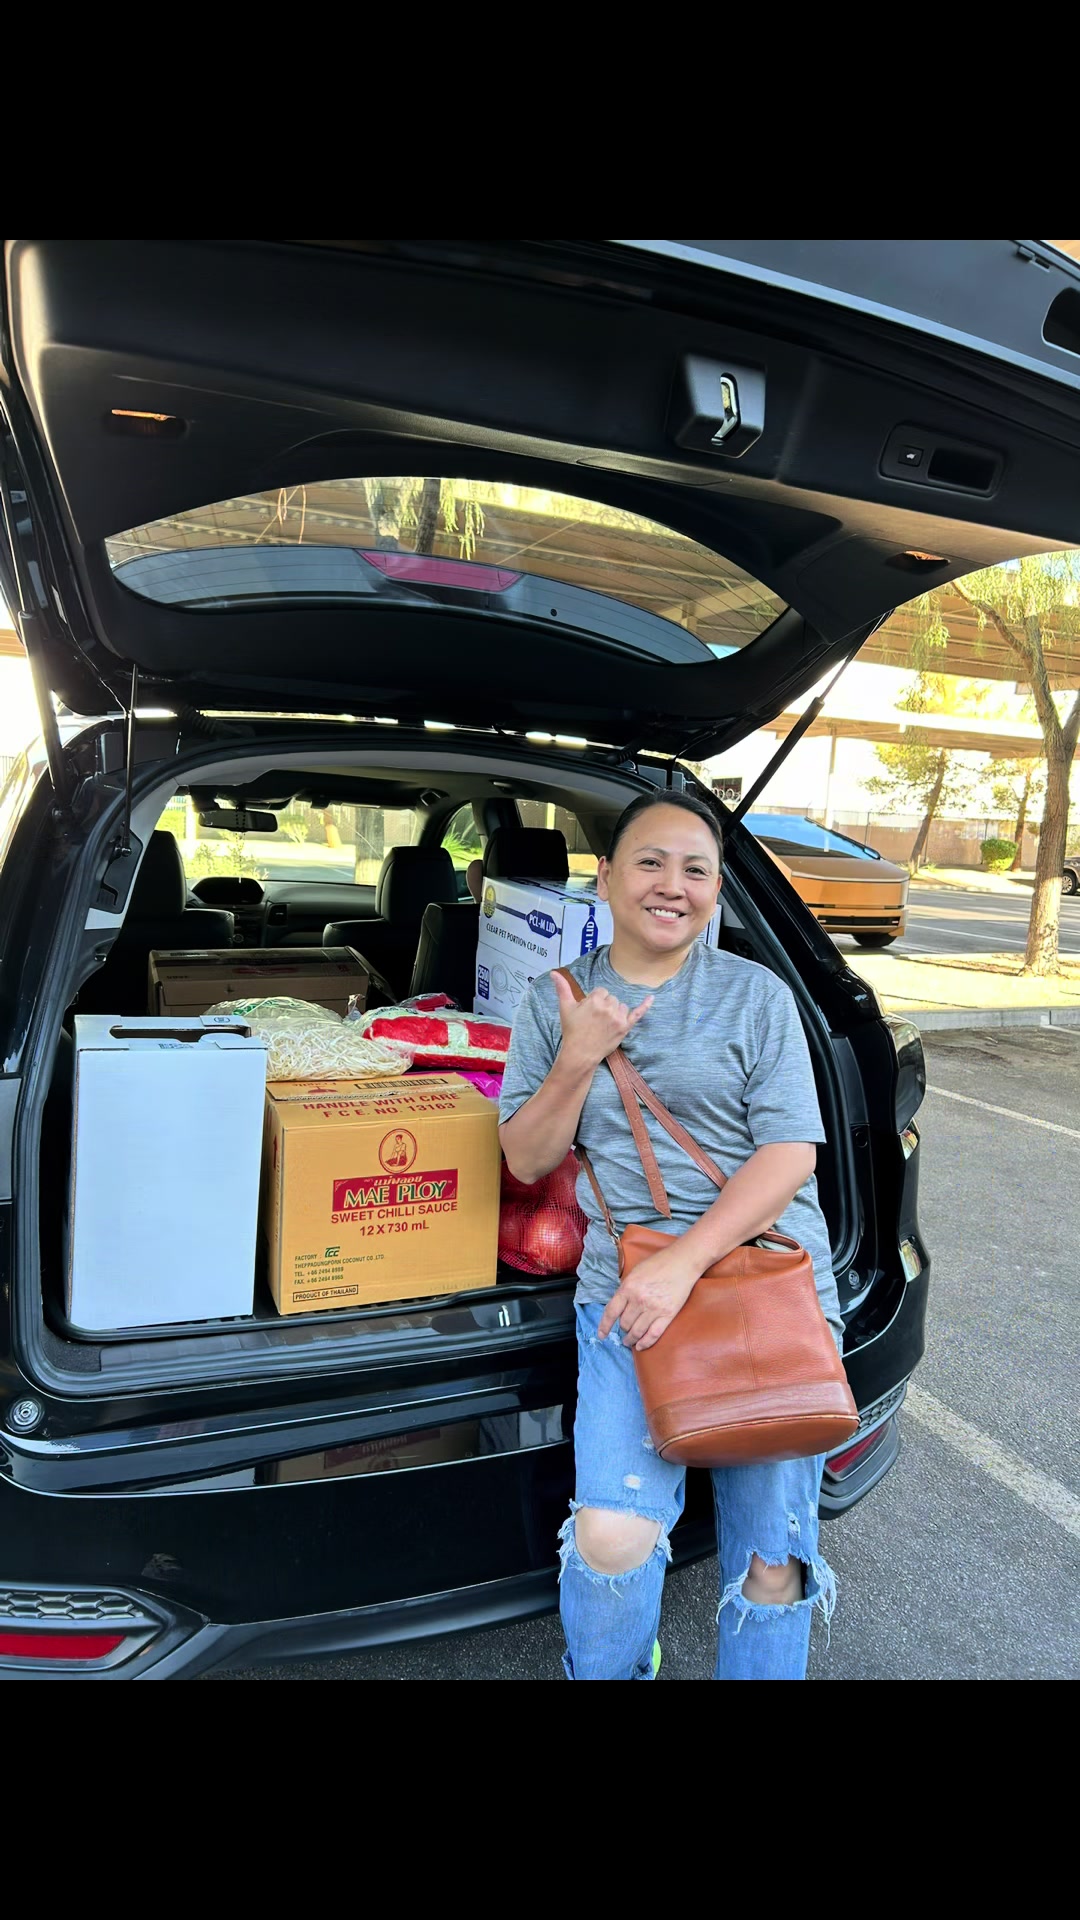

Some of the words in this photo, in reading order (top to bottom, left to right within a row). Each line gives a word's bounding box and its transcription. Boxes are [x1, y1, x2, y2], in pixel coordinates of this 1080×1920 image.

[529, 914, 545, 930] PCL-M
[546, 921, 555, 934] LID
[586, 921, 595, 937] LID
[486, 923, 499, 934] CLEAR
[507, 931, 526, 947] PORTION
[527, 941, 536, 952] CUP
[537, 945, 548, 957] LIDS
[303, 1100, 370, 1110] HANDLE
[373, 1096, 415, 1107] WITH
[419, 1093, 461, 1102] CARE
[407, 1102, 456, 1112] 13163
[343, 1185, 390, 1209] MAE
[396, 1180, 447, 1204] PLOY
[331, 1210, 375, 1224] SWEET
[377, 1205, 415, 1219] CHILLI
[418, 1201, 458, 1215] SAUCE
[387, 1221, 408, 1233] 730
[411, 1220, 429, 1231] mL
[342, 1256, 365, 1264] COCONUT
[295, 1291, 321, 1300] PRODUCT
[330, 1287, 356, 1295] THAILAND
